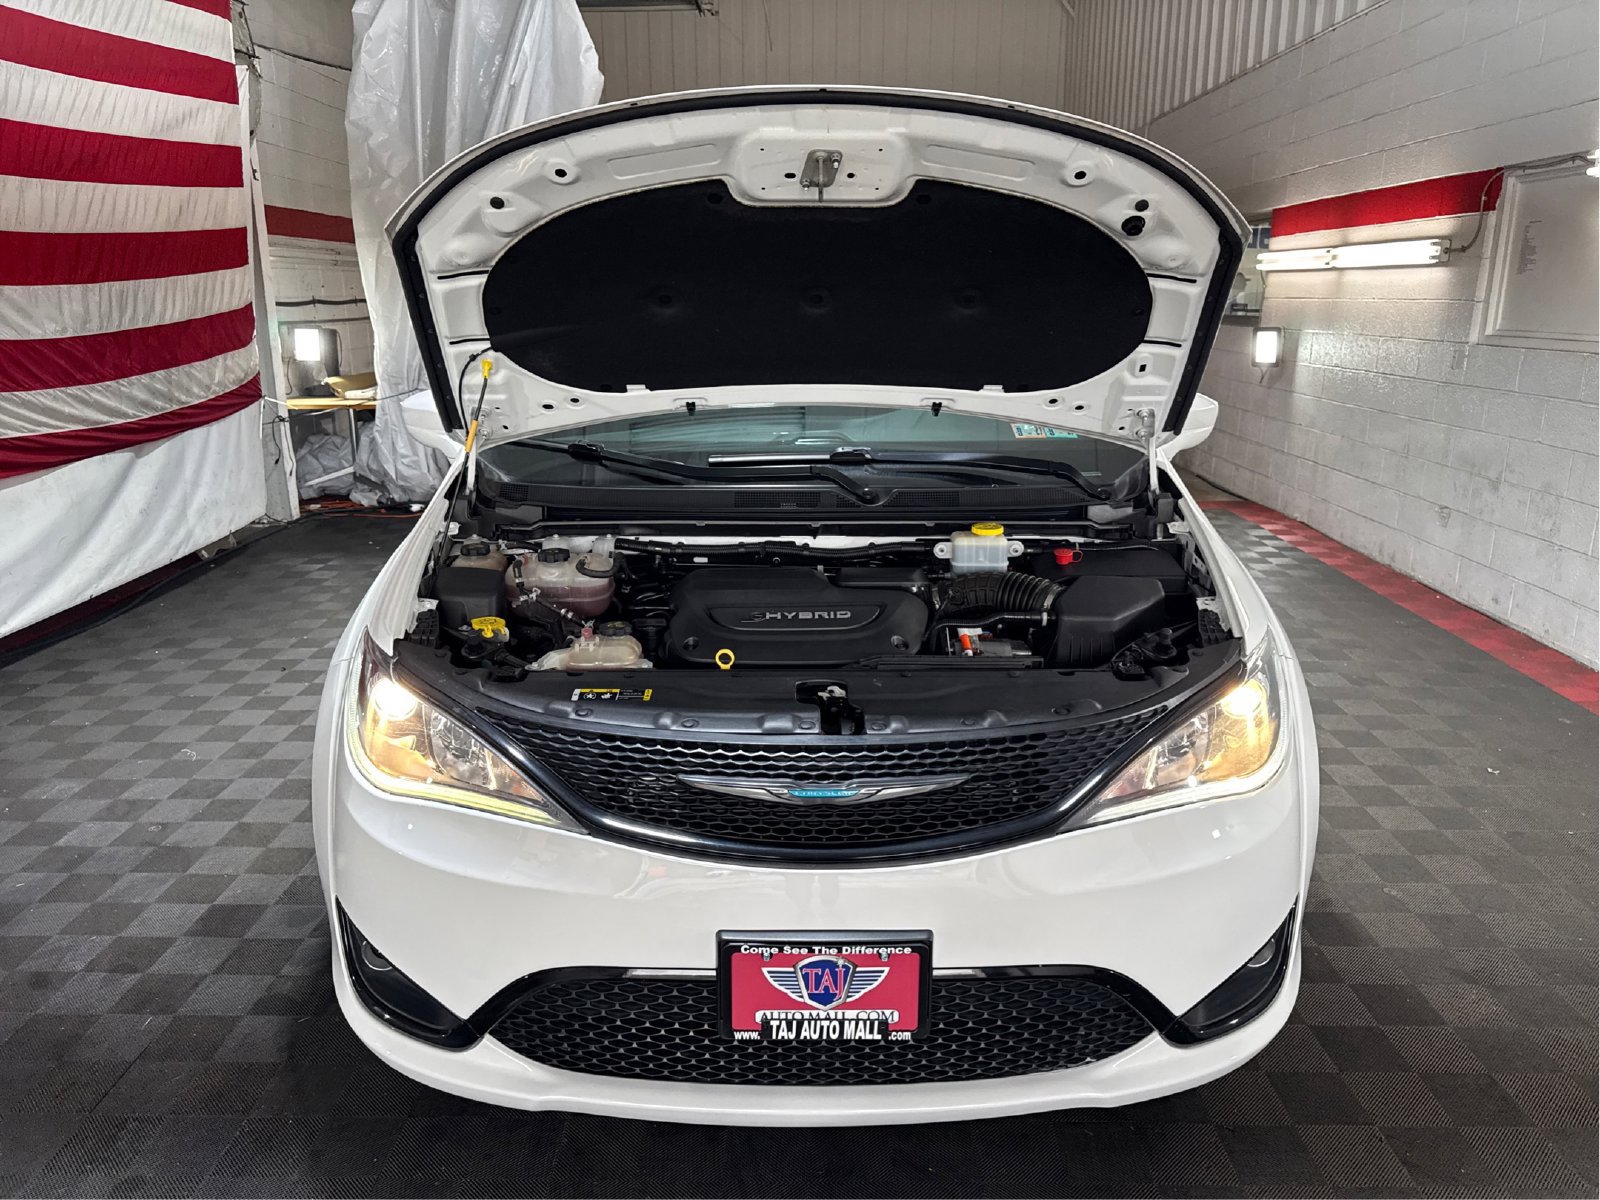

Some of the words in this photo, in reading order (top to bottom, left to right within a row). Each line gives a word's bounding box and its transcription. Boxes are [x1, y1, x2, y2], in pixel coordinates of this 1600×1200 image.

[740, 944, 779, 955] Come
[783, 945, 808, 955] See
[812, 946, 838, 955] The
[842, 946, 912, 955] Difference
[802, 967, 846, 1001] TAJ
[733, 1031, 761, 1040] www.
[770, 1020, 797, 1040] TAJ
[799, 1020, 840, 1040] AUTO
[843, 1020, 882, 1040] MALL
[888, 1031, 911, 1041] .com
